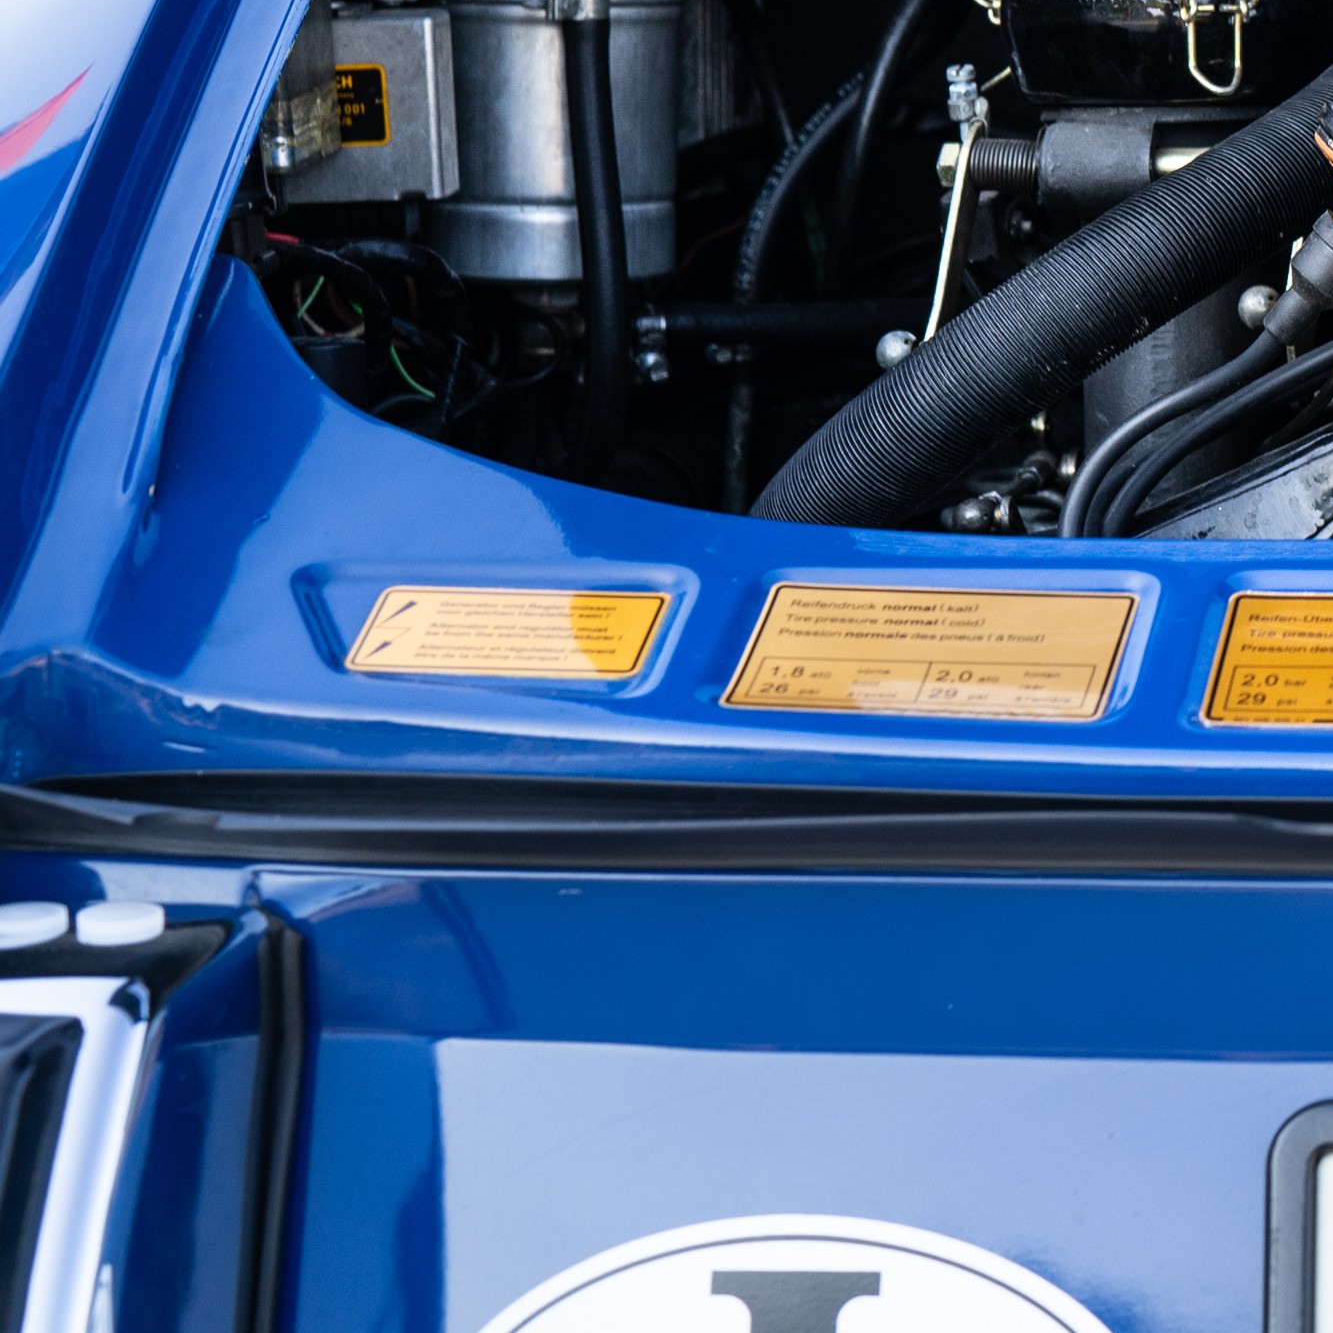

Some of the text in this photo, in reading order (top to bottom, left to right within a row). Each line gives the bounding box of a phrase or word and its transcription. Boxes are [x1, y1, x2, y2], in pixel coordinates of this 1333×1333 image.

[790, 599, 876, 611] Reifendruck
[882, 603, 936, 612] normal
[787, 614, 812, 623] Tire
[814, 616, 878, 626] pressure
[884, 618, 938, 626] normal
[778, 628, 842, 638] Pression
[845, 630, 907, 639] normale
[910, 631, 937, 640] des
[939, 633, 984, 643] pneus
[1249, 629, 1276, 637] Tire
[1241, 644, 1306, 653] Pression
[759, 682, 790, 695] 26
[928, 687, 958, 700] 29
[1236, 692, 1267, 705] 29
